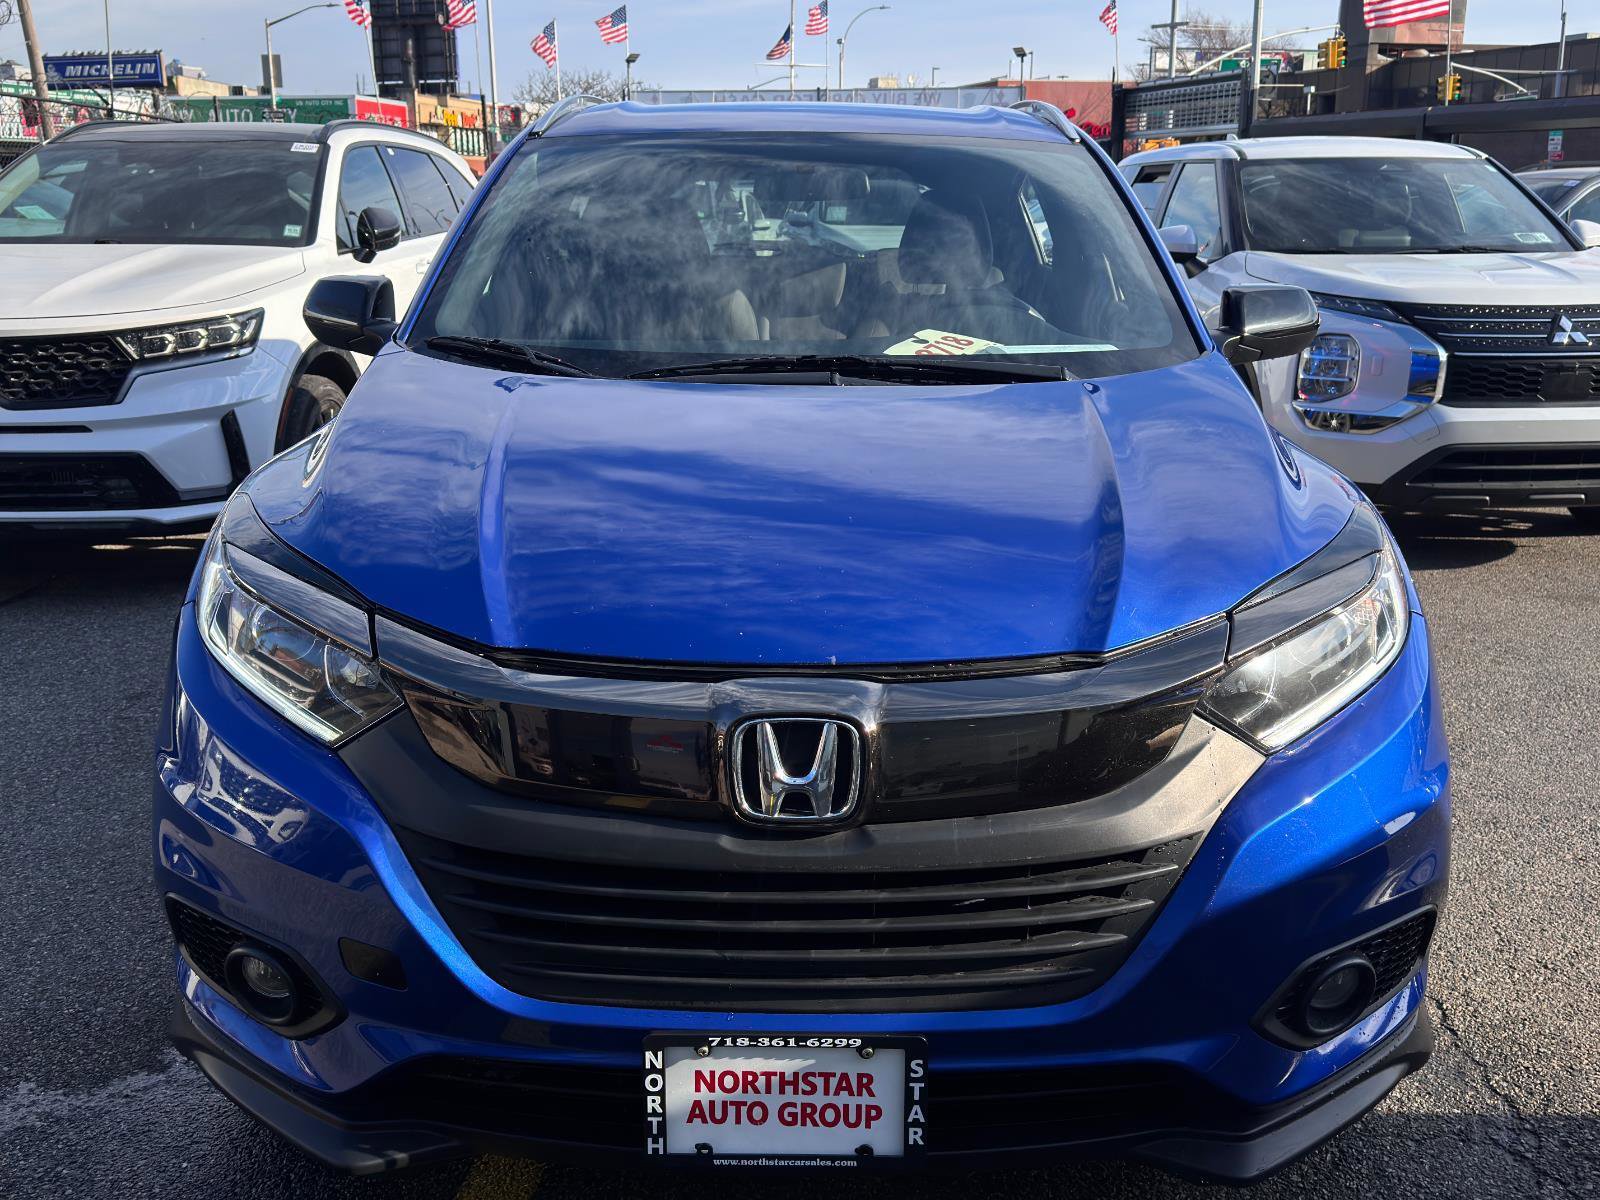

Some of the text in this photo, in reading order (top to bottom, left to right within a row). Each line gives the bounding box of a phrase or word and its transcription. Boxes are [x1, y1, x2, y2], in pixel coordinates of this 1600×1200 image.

[65, 63, 156, 77] MICHELIN
[208, 108, 254, 123] AUTO
[708, 1037, 862, 1048] 718-361-6299
[694, 1069, 876, 1097] NORTHSTAR
[644, 1050, 664, 1155] NORTH
[907, 1059, 926, 1145] STAR
[686, 1099, 883, 1130] AUTO GROUP
[713, 1158, 858, 1168] www.northstarcarsales.com
